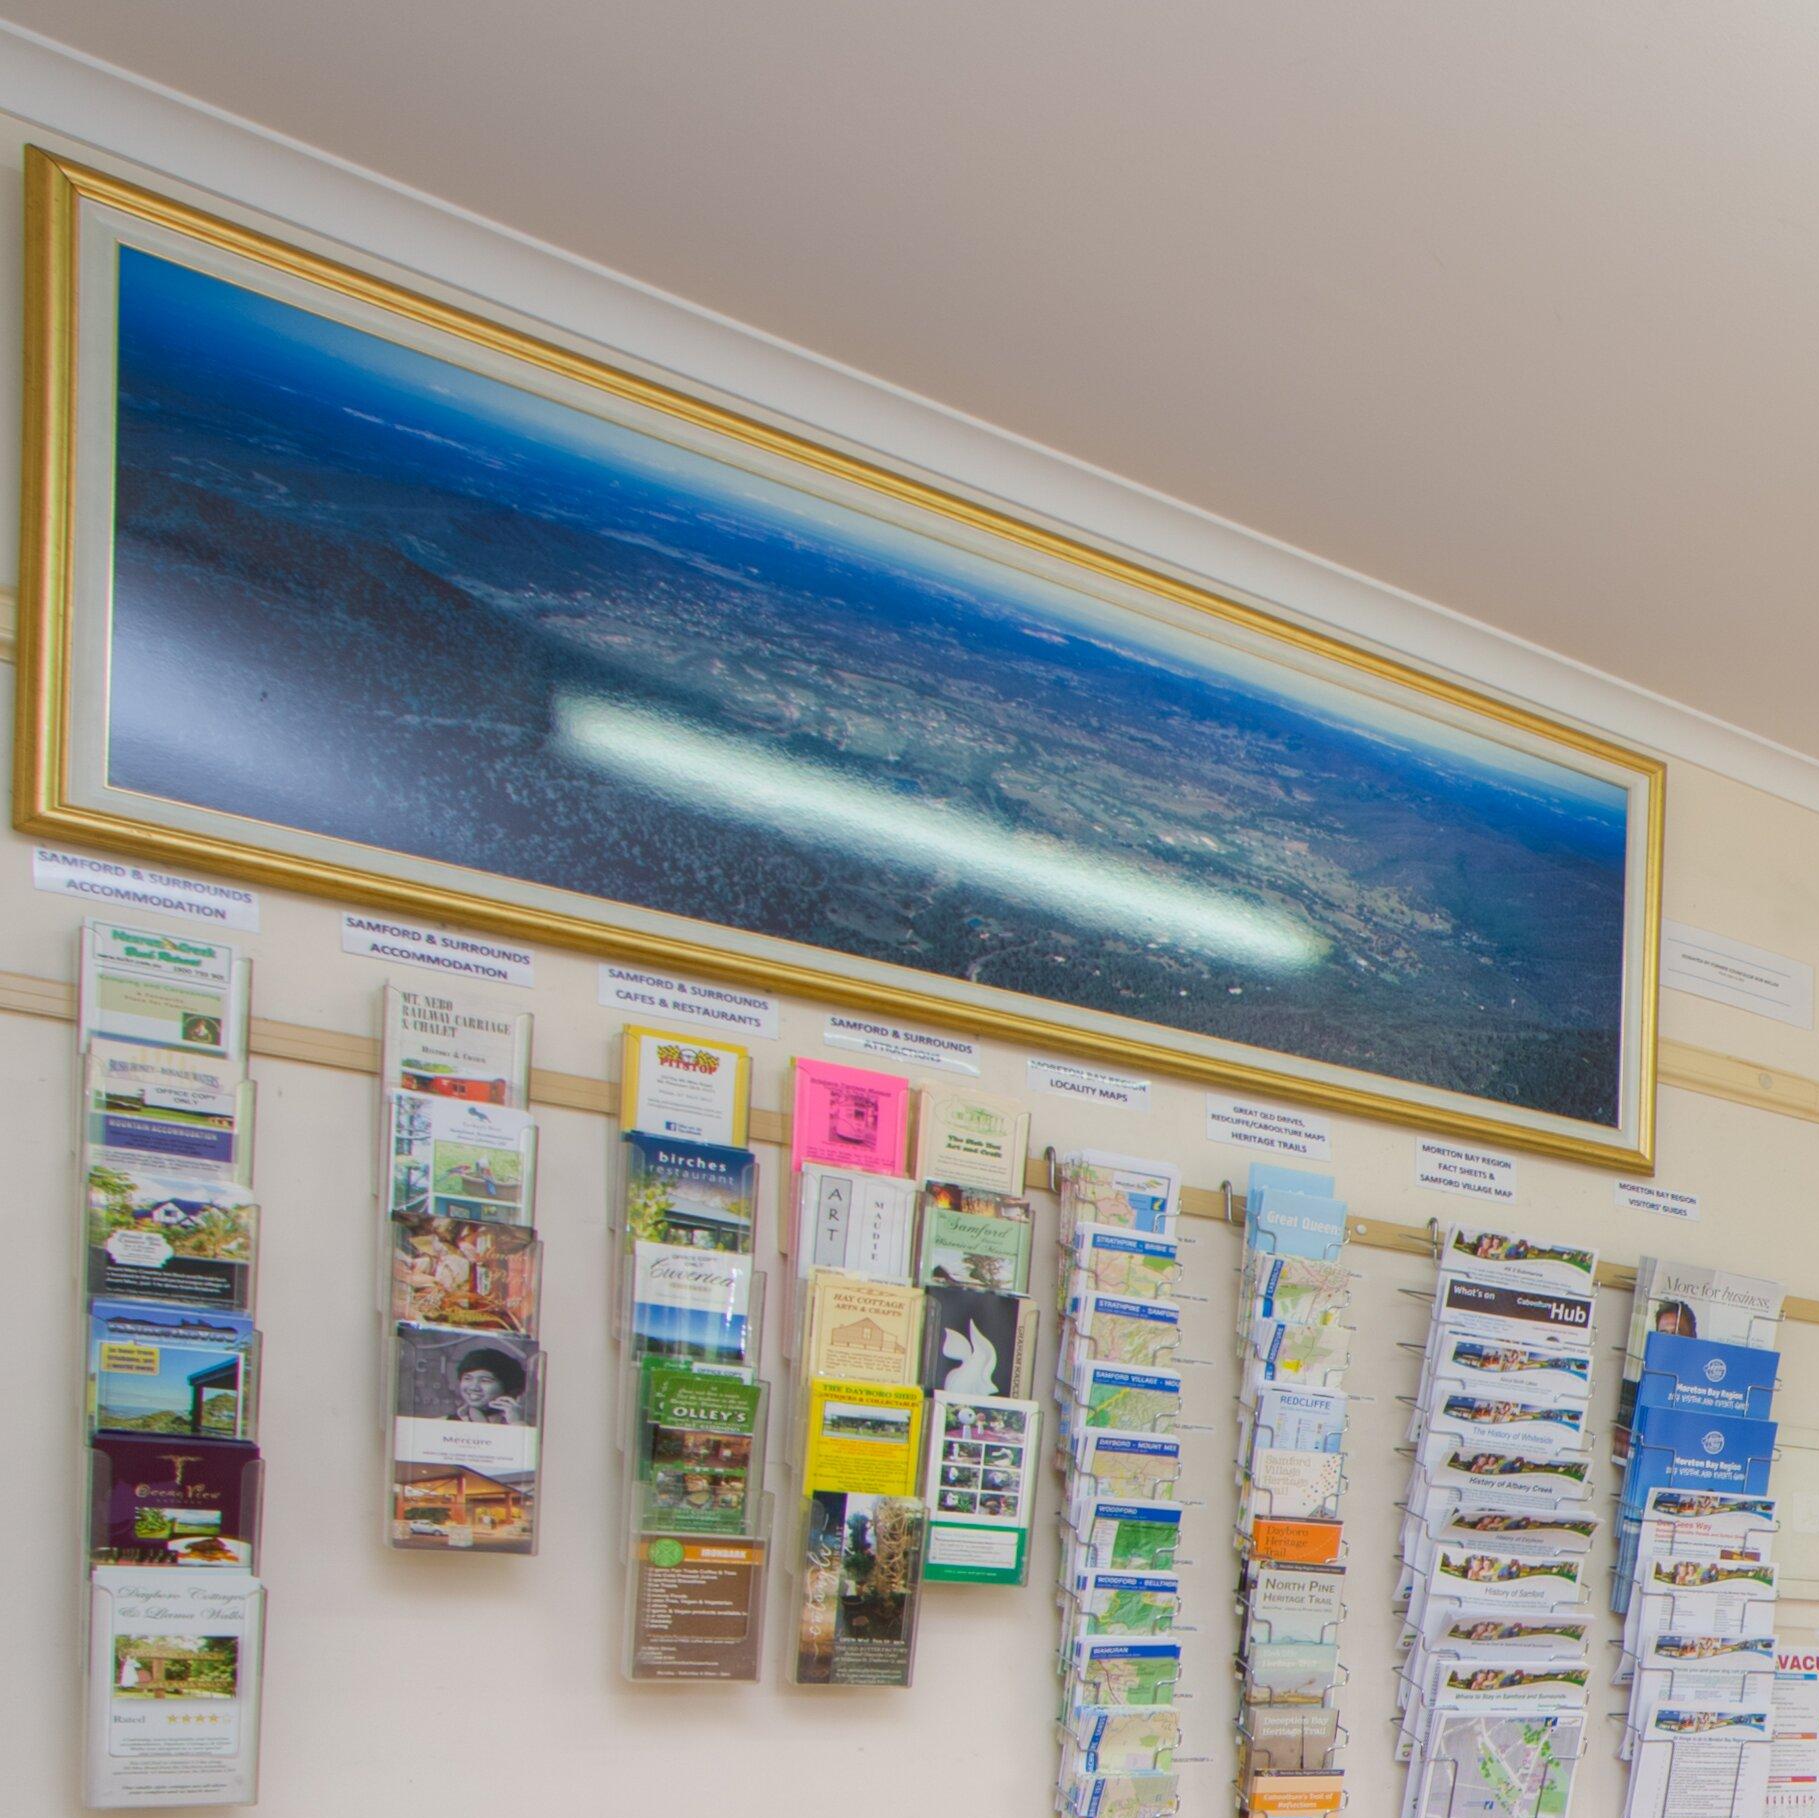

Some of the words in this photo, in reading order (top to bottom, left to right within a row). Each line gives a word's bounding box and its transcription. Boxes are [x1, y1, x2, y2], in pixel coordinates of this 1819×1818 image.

[37, 849, 127, 878] SAMFORD
[131, 869, 145, 882] &
[149, 872, 253, 904] SURROUNDS
[66, 878, 227, 919] ACCOMMODATION
[346, 916, 421, 941] SAMFORD
[425, 934, 437, 945] &
[441, 938, 531, 966] SURROUNDS
[370, 943, 509, 980] ACCOMMODATION
[608, 968, 674, 991] SAMFORD
[677, 983, 688, 993] &
[690, 985, 770, 1010] SURROUNDS
[616, 989, 655, 1006] CAFES
[658, 998, 669, 1008] &
[672, 1000, 762, 1028] RESTAURANTS
[402, 1006, 452, 1027] RAILWAY
[455, 1015, 512, 1036] CARRIAGE
[831, 1017, 889, 1037] SAMFORD
[891, 1029, 901, 1039] &
[904, 1032, 973, 1054] SURROUNDS
[656, 1056, 719, 1076] PITSTOP
[1050, 1078, 1097, 1097] LOCALITY
[1099, 1088, 1128, 1103] MAPS
[1233, 1105, 1258, 1118] GREAT
[1211, 1113, 1303, 1138] REDCLIFFE/CABOOLTURE
[1304, 1131, 1326, 1143] MAPS
[1231, 1131, 1276, 1147] HERITAGE
[1278, 1140, 1307, 1154] TRAILS
[658, 1151, 727, 1173] birches
[1421, 1144, 1463, 1160] MORETON
[1464, 1153, 1481, 1163] BAY
[1482, 1156, 1512, 1170] REGION
[649, 1164, 736, 1187] restaurant
[1438, 1162, 1457, 1174] FACT
[1458, 1167, 1488, 1180] SHEETS
[1488, 1172, 1496, 1180] &
[1420, 1174, 1460, 1188] SAMFORD
[1461, 1182, 1493, 1195] VILLAGE
[1494, 1188, 1513, 1198] MAP
[1618, 1182, 1655, 1197] MORETON
[1656, 1190, 1670, 1199] BAY
[1671, 1193, 1697, 1205] REGION
[1266, 1210, 1298, 1228] Great
[1662, 1204, 1688, 1217] GUIDES
[948, 1216, 1014, 1239] Samford
[1453, 1285, 1483, 1299] What's
[1484, 1290, 1496, 1300] on
[1666, 1275, 1699, 1299] More
[1701, 1281, 1720, 1300] for
[857, 1295, 907, 1311] COTTAGE
[1551, 1302, 1587, 1324] Hub
[822, 1383, 842, 1393] THE
[845, 1386, 892, 1399] DAYBORO
[894, 1391, 918, 1401] SHED
[1707, 1388, 1721, 1398] Bay
[1721, 1390, 1743, 1400] Region
[1280, 1395, 1331, 1410] REDCLIFFE
[672, 1406, 747, 1424] OLLEY'S
[441, 1434, 493, 1448] Mercure
[1473, 1426, 1486, 1436] The
[1487, 1428, 1511, 1439] History
[1512, 1431, 1520, 1440] of
[1469, 1476, 1495, 1488] History
[1496, 1479, 1505, 1488] of
[1506, 1481, 1531, 1493] Albany
[1532, 1484, 1553, 1494] Creek
[1266, 1524, 1310, 1538] Dayboro
[1264, 1537, 1308, 1550] Heritage
[1265, 1547, 1287, 1558] Trail
[1484, 1587, 1510, 1599] History
[1511, 1588, 1520, 1598] of
[1520, 1589, 1545, 1599] Samford
[113, 1715, 146, 1725] Rated
[1263, 1716, 1308, 1729] Deception
[1310, 1717, 1330, 1729] Bay
[1262, 1726, 1302, 1737] Heritage
[1303, 1727, 1327, 1737] Trail
